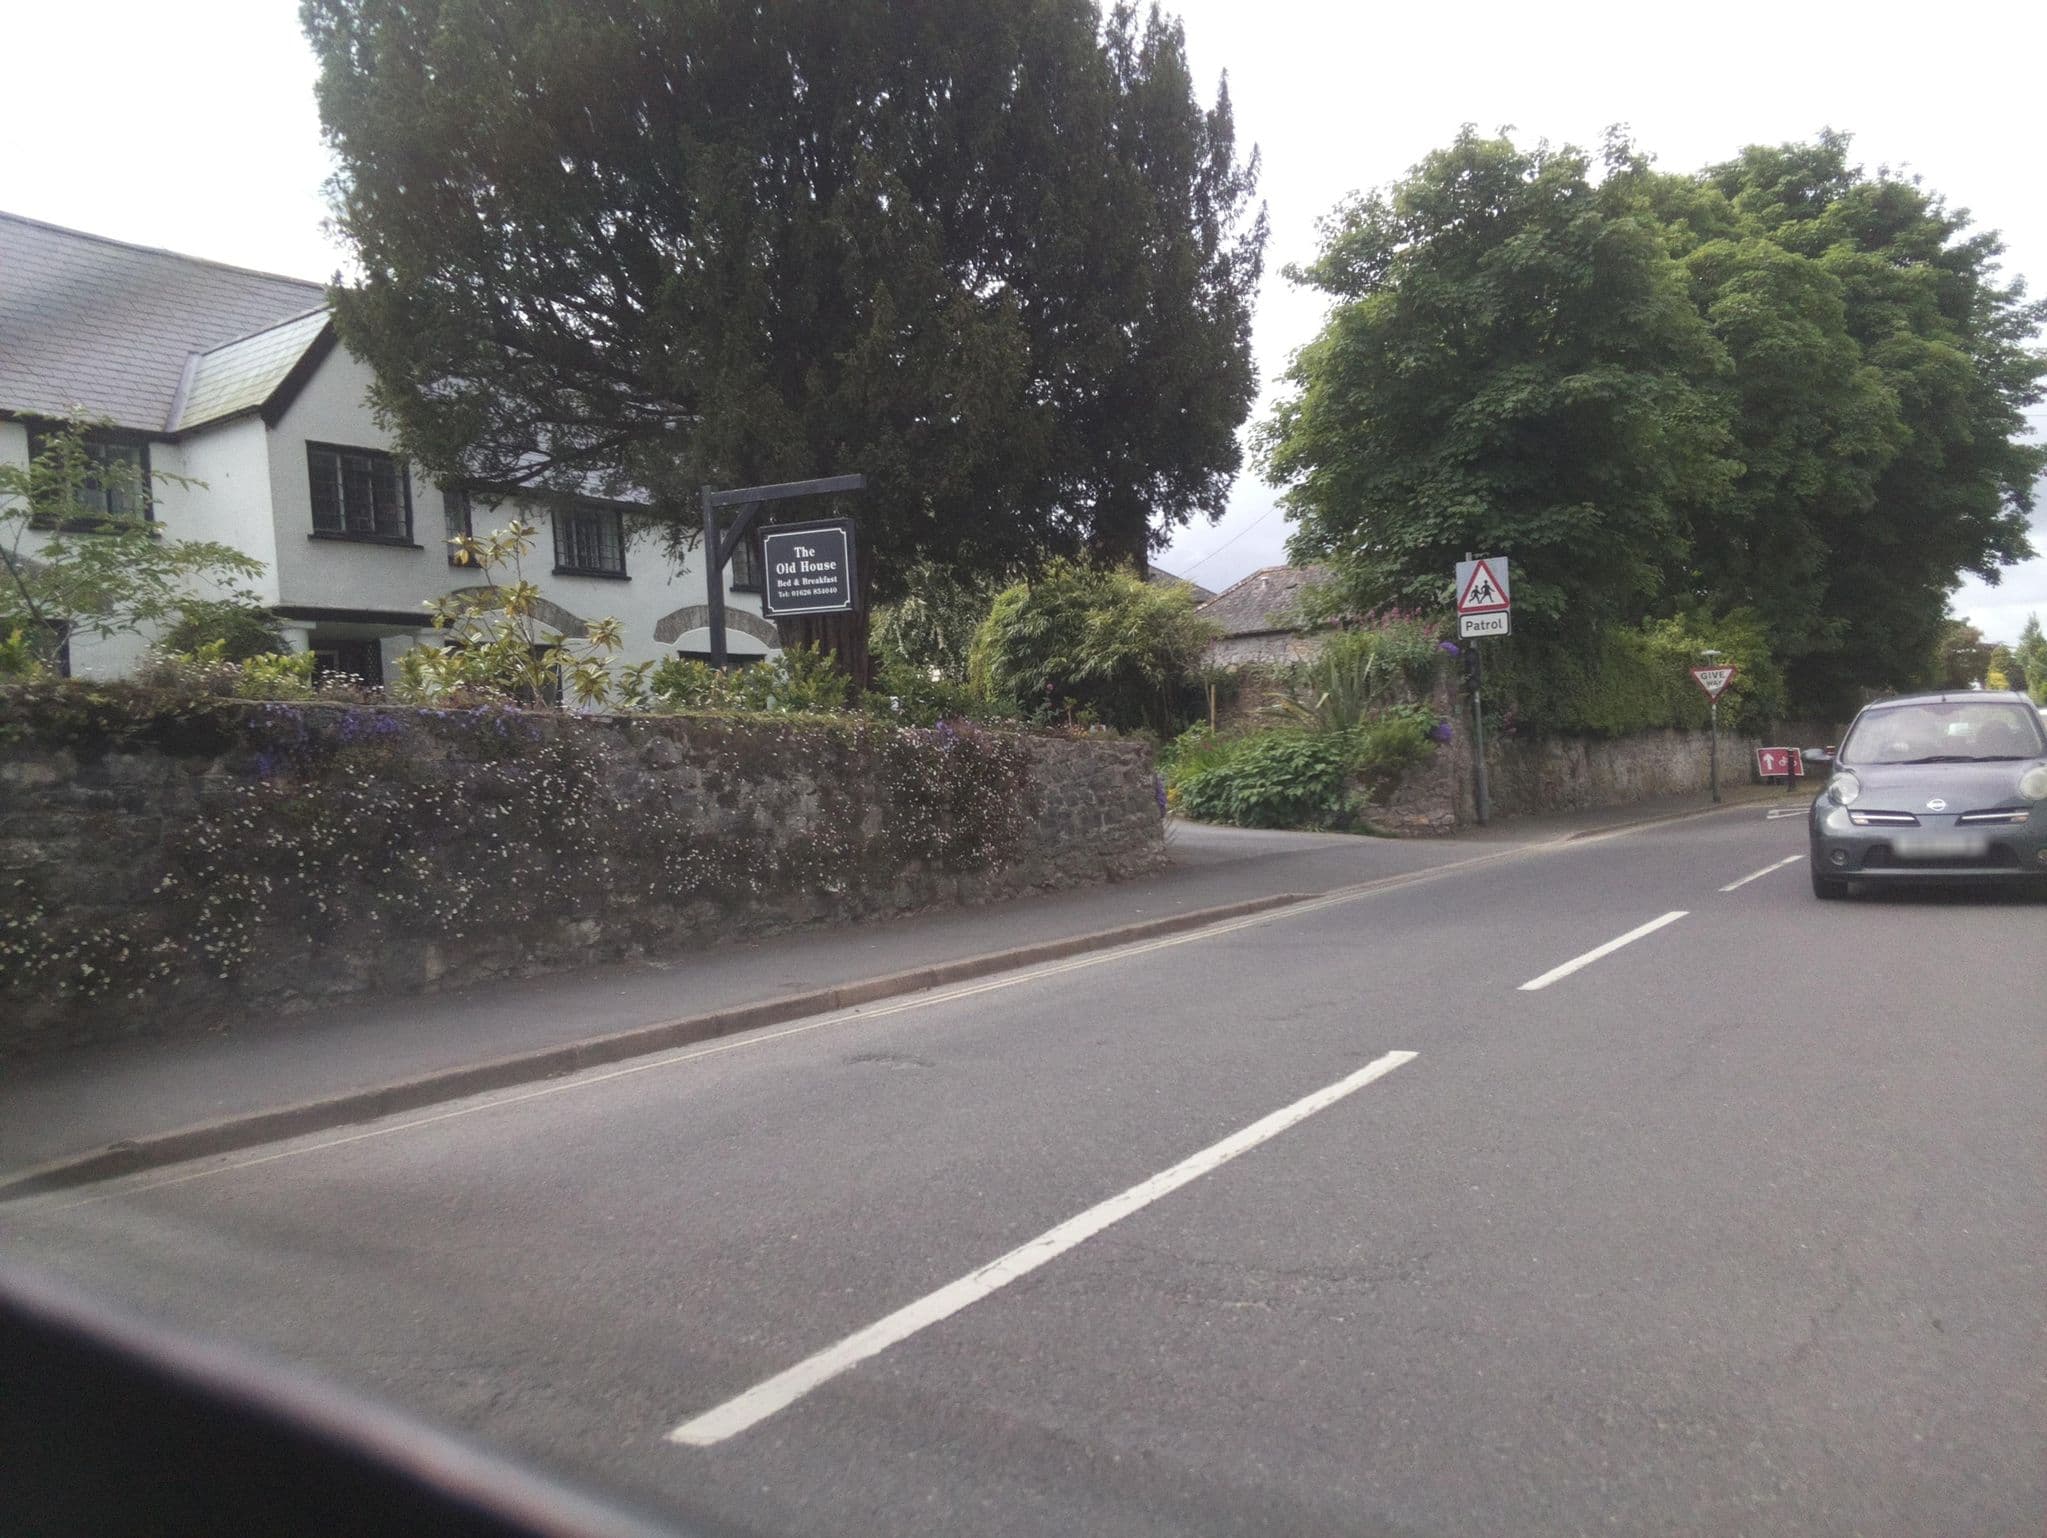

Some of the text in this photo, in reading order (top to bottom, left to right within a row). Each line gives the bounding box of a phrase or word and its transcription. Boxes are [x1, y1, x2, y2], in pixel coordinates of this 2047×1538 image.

[794, 546, 815, 558] The
[776, 561, 836, 574] Old House
[777, 576, 838, 587] Bed & Breakfast
[1466, 618, 1502, 631] Patrol
[1701, 671, 1725, 679] GIVE
